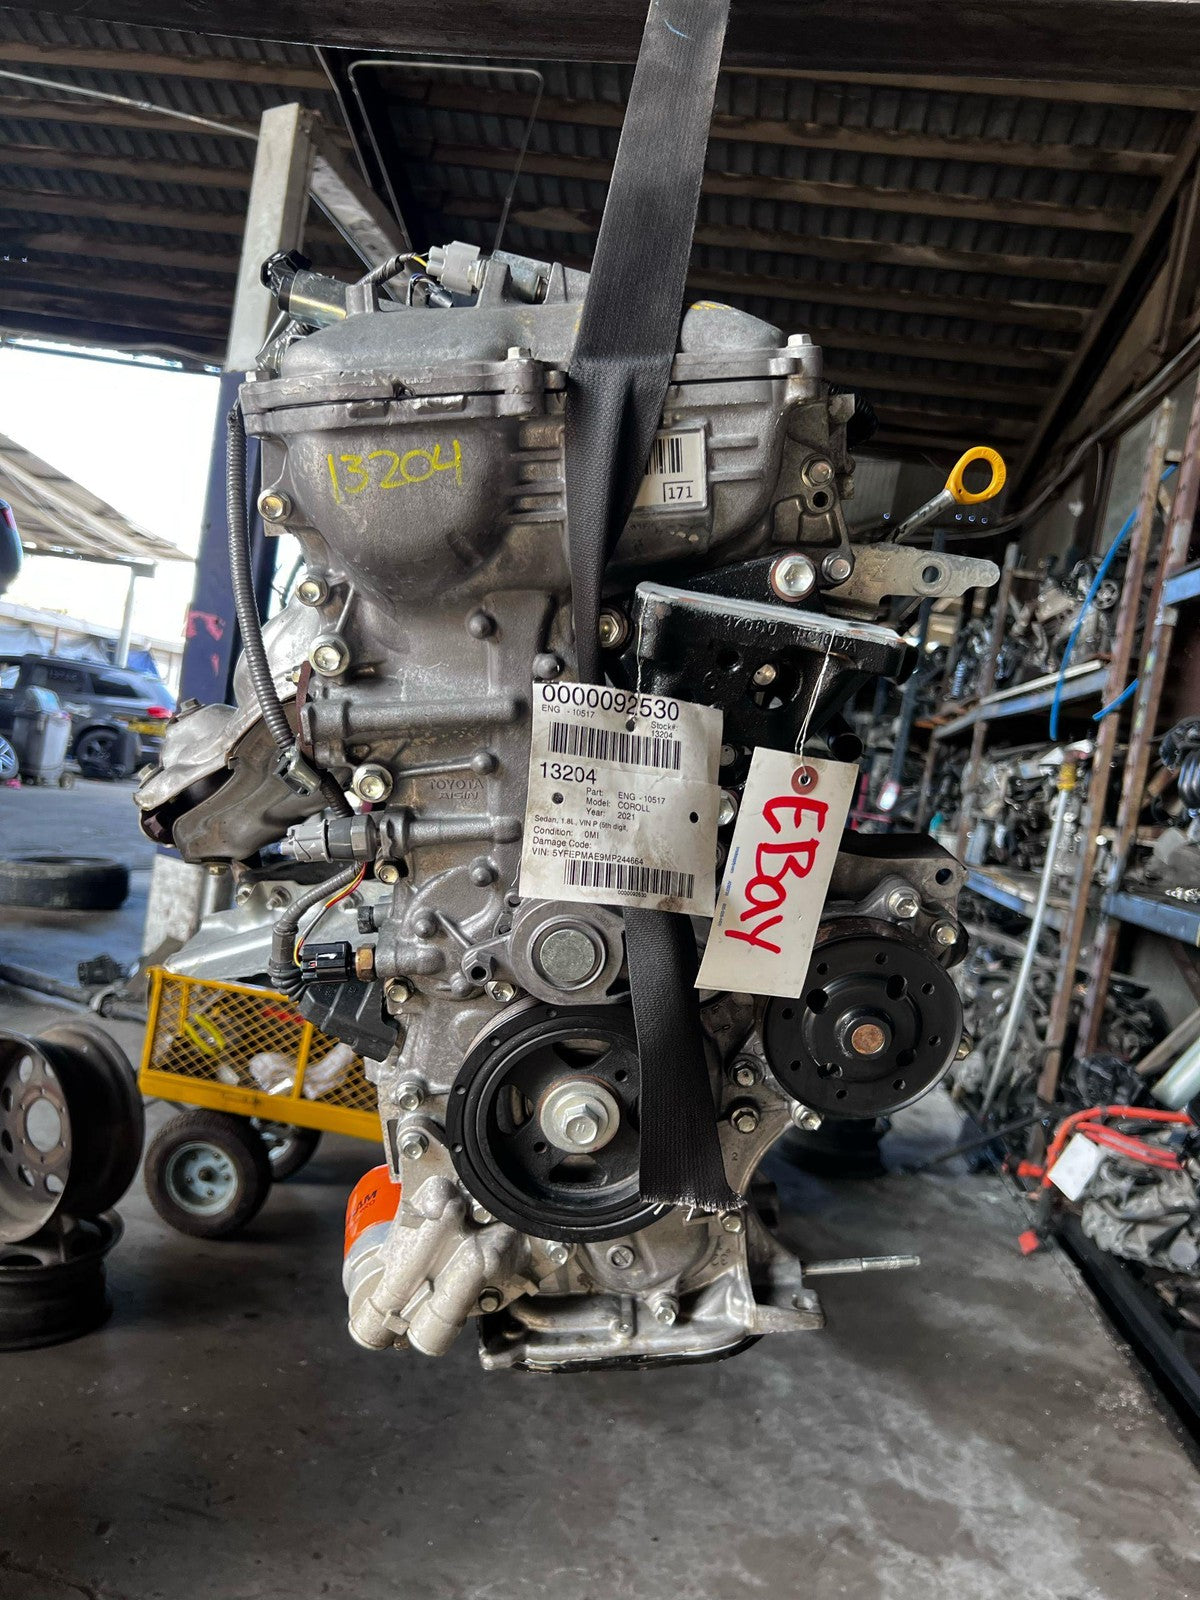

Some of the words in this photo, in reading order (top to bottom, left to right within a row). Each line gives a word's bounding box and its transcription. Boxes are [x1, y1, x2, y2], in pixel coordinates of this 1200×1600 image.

[327, 439, 463, 504] 13204
[668, 486, 693, 500] 171
[542, 684, 680, 721] 0000092530
[541, 704, 561, 714] ENG
[572, 709, 595, 719] 10517
[651, 721, 679, 732] Stock#:
[651, 730, 673, 739] 13204
[540, 762, 597, 784] 13204
[586, 787, 604, 797] Part:
[618, 791, 636, 801] ENG
[644, 795, 666, 805] 10517
[586, 797, 611, 807] Model:
[617, 801, 650, 813] COROLL
[586, 807, 605, 817] Year:
[617, 812, 635, 820] 2021
[533, 825, 573, 837] Condition:
[532, 836, 567, 848] Damage
[568, 840, 592, 849] Code:
[532, 847, 549, 857] VIN:
[552, 849, 644, 866] 5YFEPMAE9MP244664
